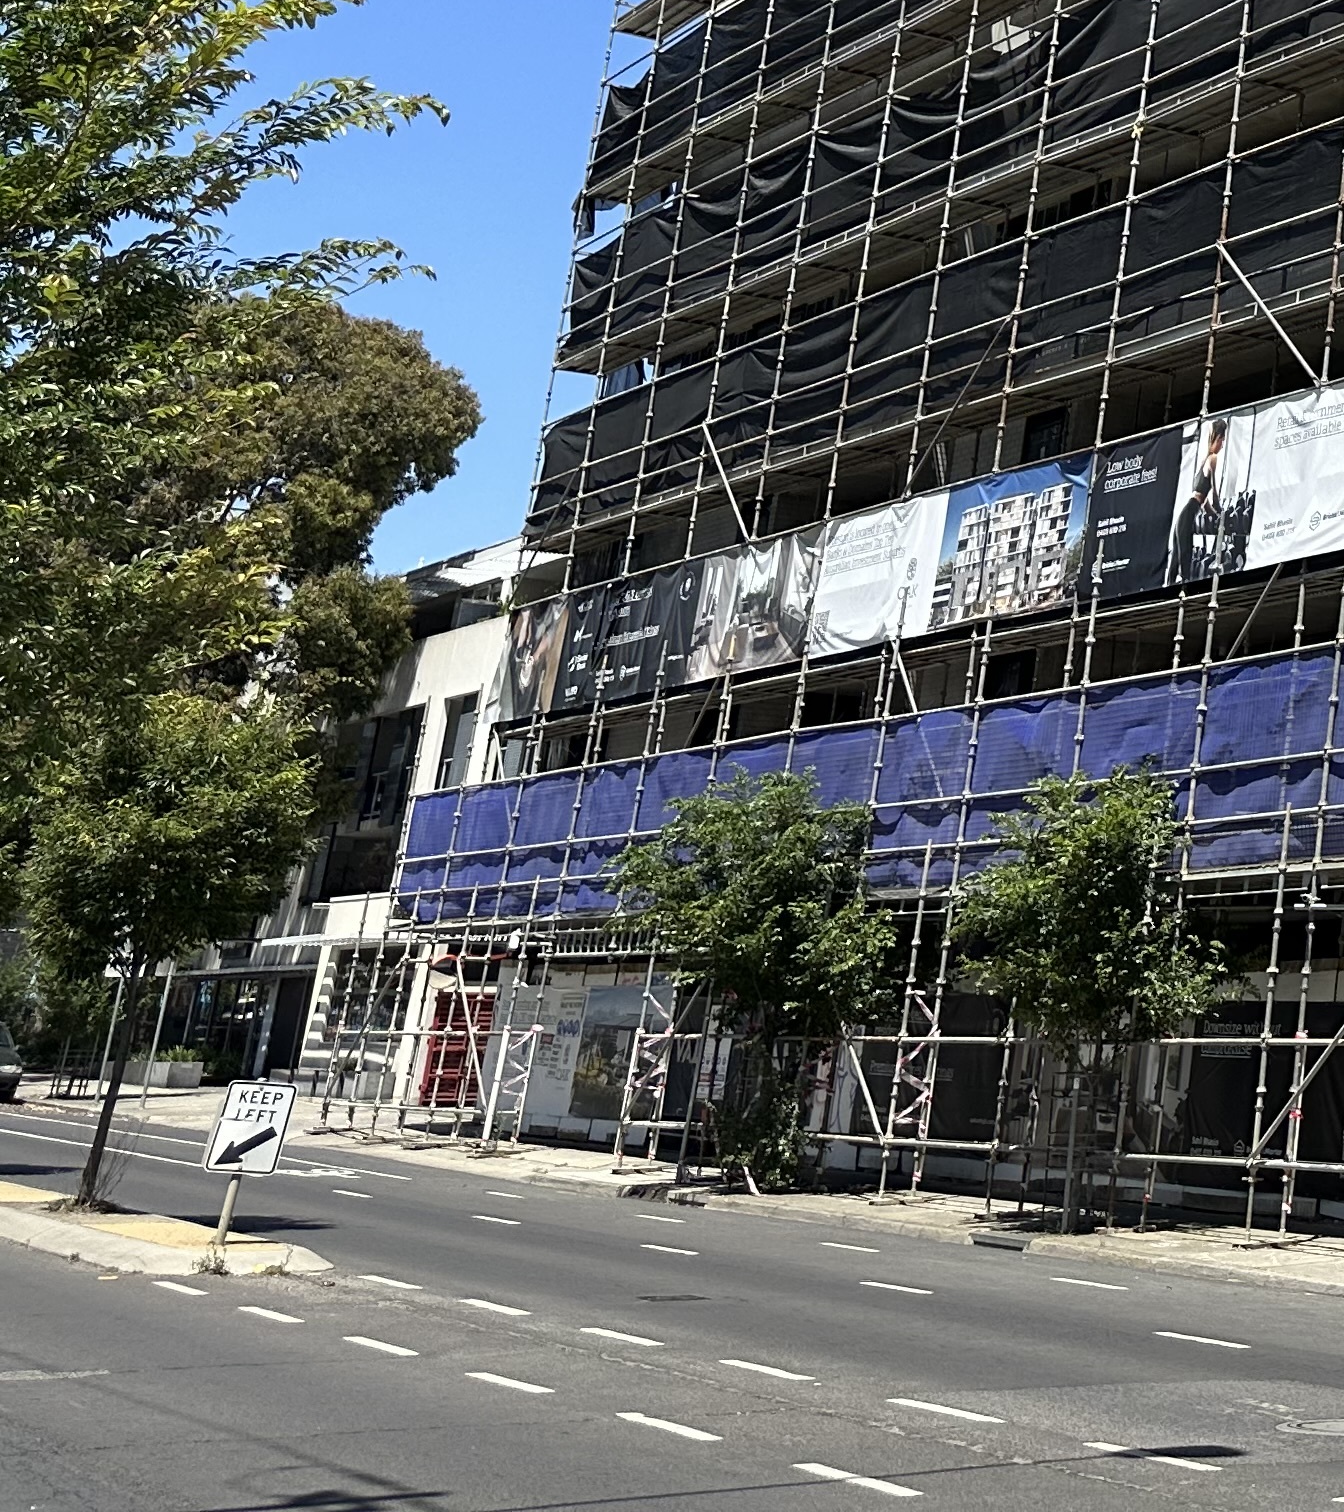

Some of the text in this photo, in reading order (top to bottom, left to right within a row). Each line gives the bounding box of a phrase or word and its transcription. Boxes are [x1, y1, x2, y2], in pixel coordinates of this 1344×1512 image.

[1274, 430, 1302, 449] spaces
[1302, 419, 1342, 440] available
[1106, 454, 1144, 474] Low body
[1104, 472, 1141, 490] corporate
[1203, 1019, 1243, 1035] Downsize
[239, 1089, 284, 1106] KEEP
[234, 1107, 278, 1124] LEFT
